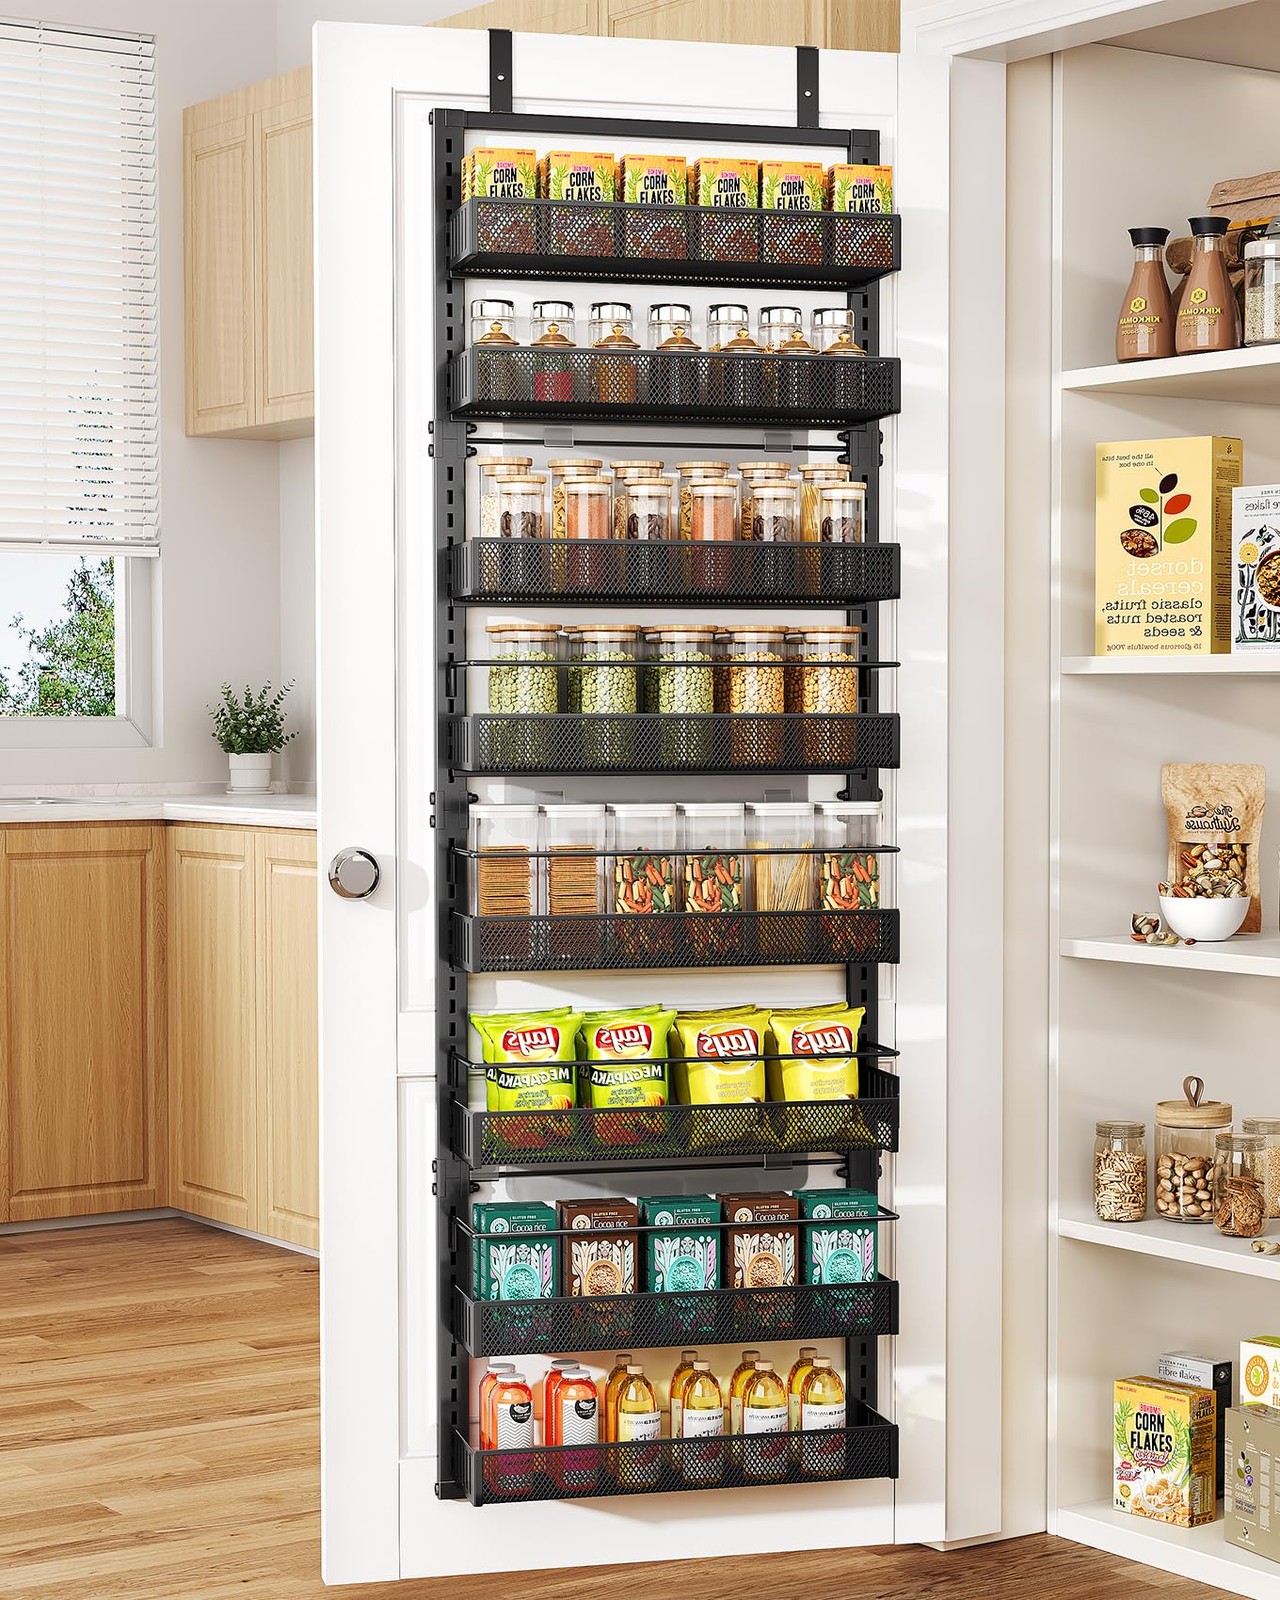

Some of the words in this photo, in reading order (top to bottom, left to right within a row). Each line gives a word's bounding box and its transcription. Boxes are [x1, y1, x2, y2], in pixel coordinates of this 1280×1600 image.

[493, 169, 517, 184] CORN
[570, 171, 594, 187] CORN
[644, 175, 667, 190] CORN
[490, 184, 523, 197] FLAKES
[718, 178, 740, 193] CORN
[781, 181, 804, 195] CORN
[852, 184, 874, 199] CORN
[566, 187, 601, 201] FLAKES
[640, 190, 673, 203] FLAKES
[714, 193, 746, 207] FLAKES
[777, 196, 810, 210] FLAKES
[849, 199, 880, 213] FLAKES
[755, 1212, 776, 1222] Cocoa
[777, 1212, 789, 1221] rice
[834, 1209, 855, 1218] Cocoa
[857, 1208, 869, 1217] rice
[512, 1223, 533, 1231] Cocoa
[534, 1222, 546, 1231] rice
[593, 1220, 615, 1228] Cocoa
[616, 1219, 628, 1227] rice
[676, 1216, 698, 1225] Cocoa
[699, 1216, 710, 1224] rice
[1159, 1366, 1178, 1377] Fibre
[1179, 1369, 1201, 1382] flakes
[1136, 1412, 1165, 1432] CORN
[1130, 1431, 1172, 1452] FLAKES
